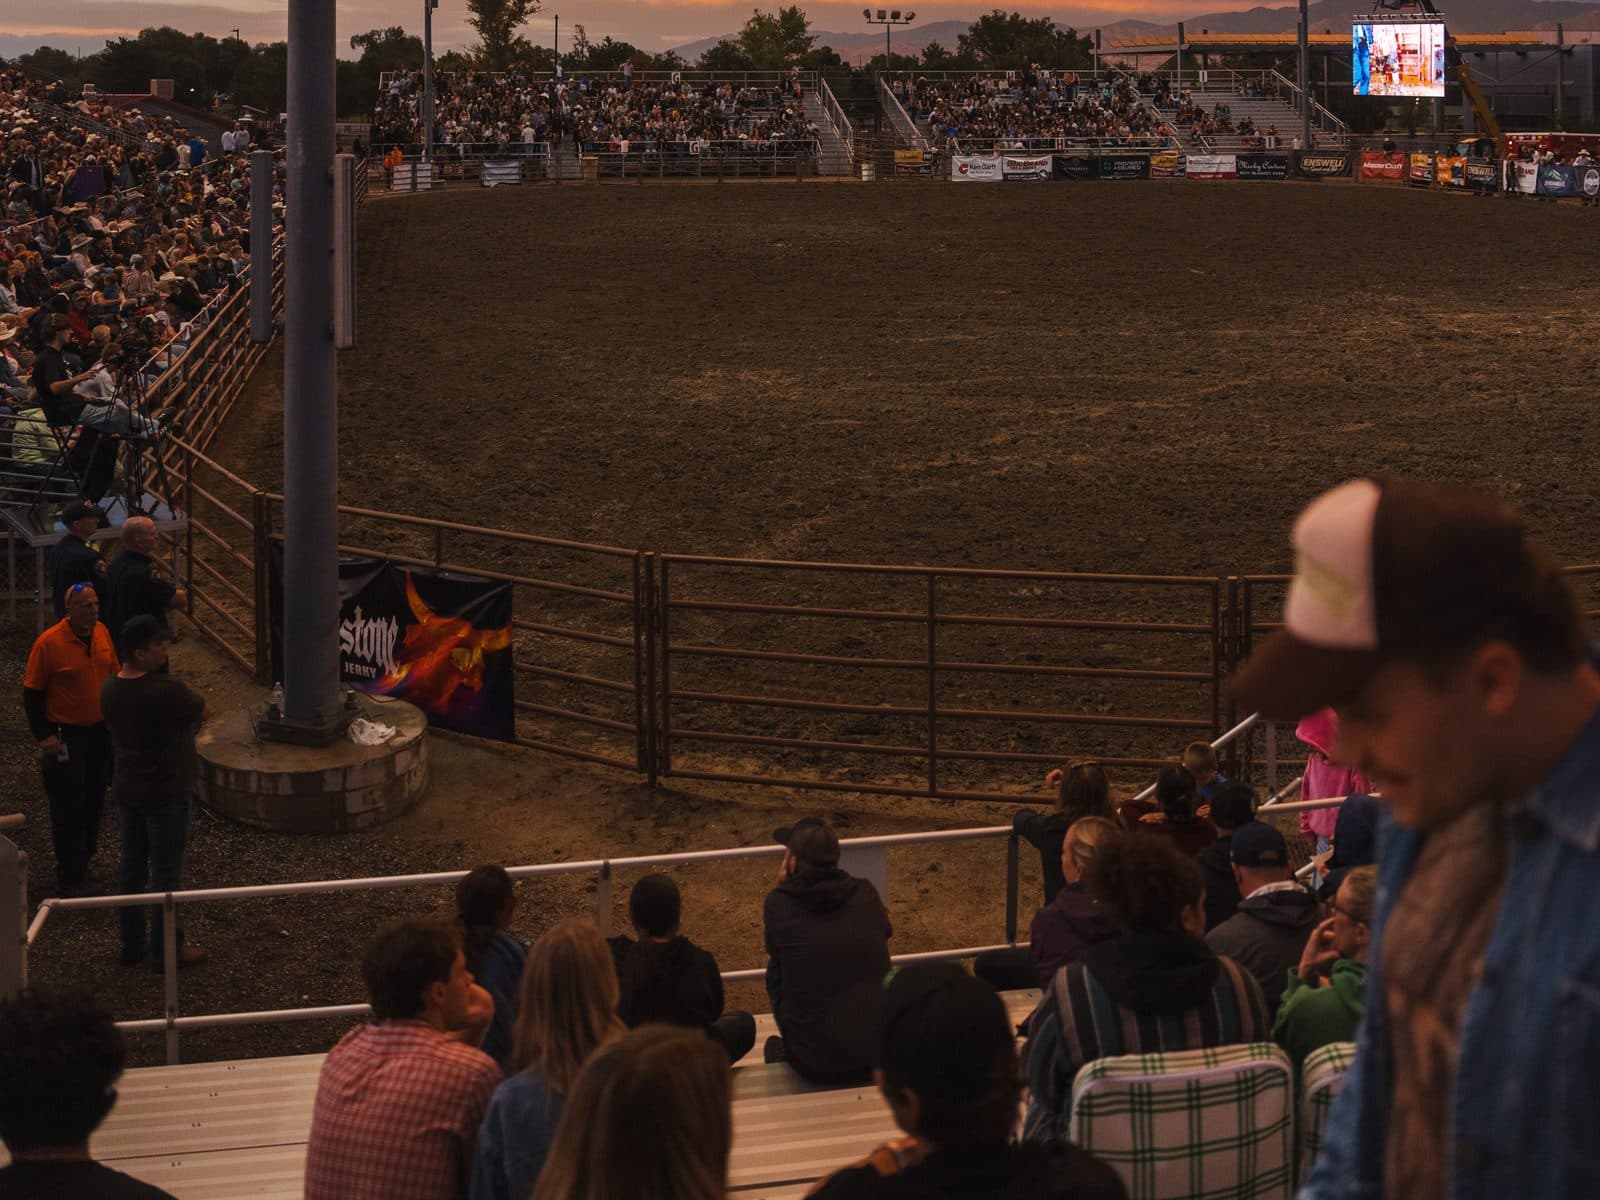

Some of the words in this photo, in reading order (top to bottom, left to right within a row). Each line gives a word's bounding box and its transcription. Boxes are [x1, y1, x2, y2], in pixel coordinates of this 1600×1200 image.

[673, 73, 679, 84] G
[691, 142, 698, 153] G
[1056, 138, 1063, 150] H
[1237, 160, 1262, 171] Minky
[1303, 158, 1343, 167] ENSWELL
[1362, 162, 1403, 170] MasterCraft
[1467, 165, 1495, 177] ENSWELL
[339, 604, 399, 678] stone
[344, 662, 377, 679] JERKY
